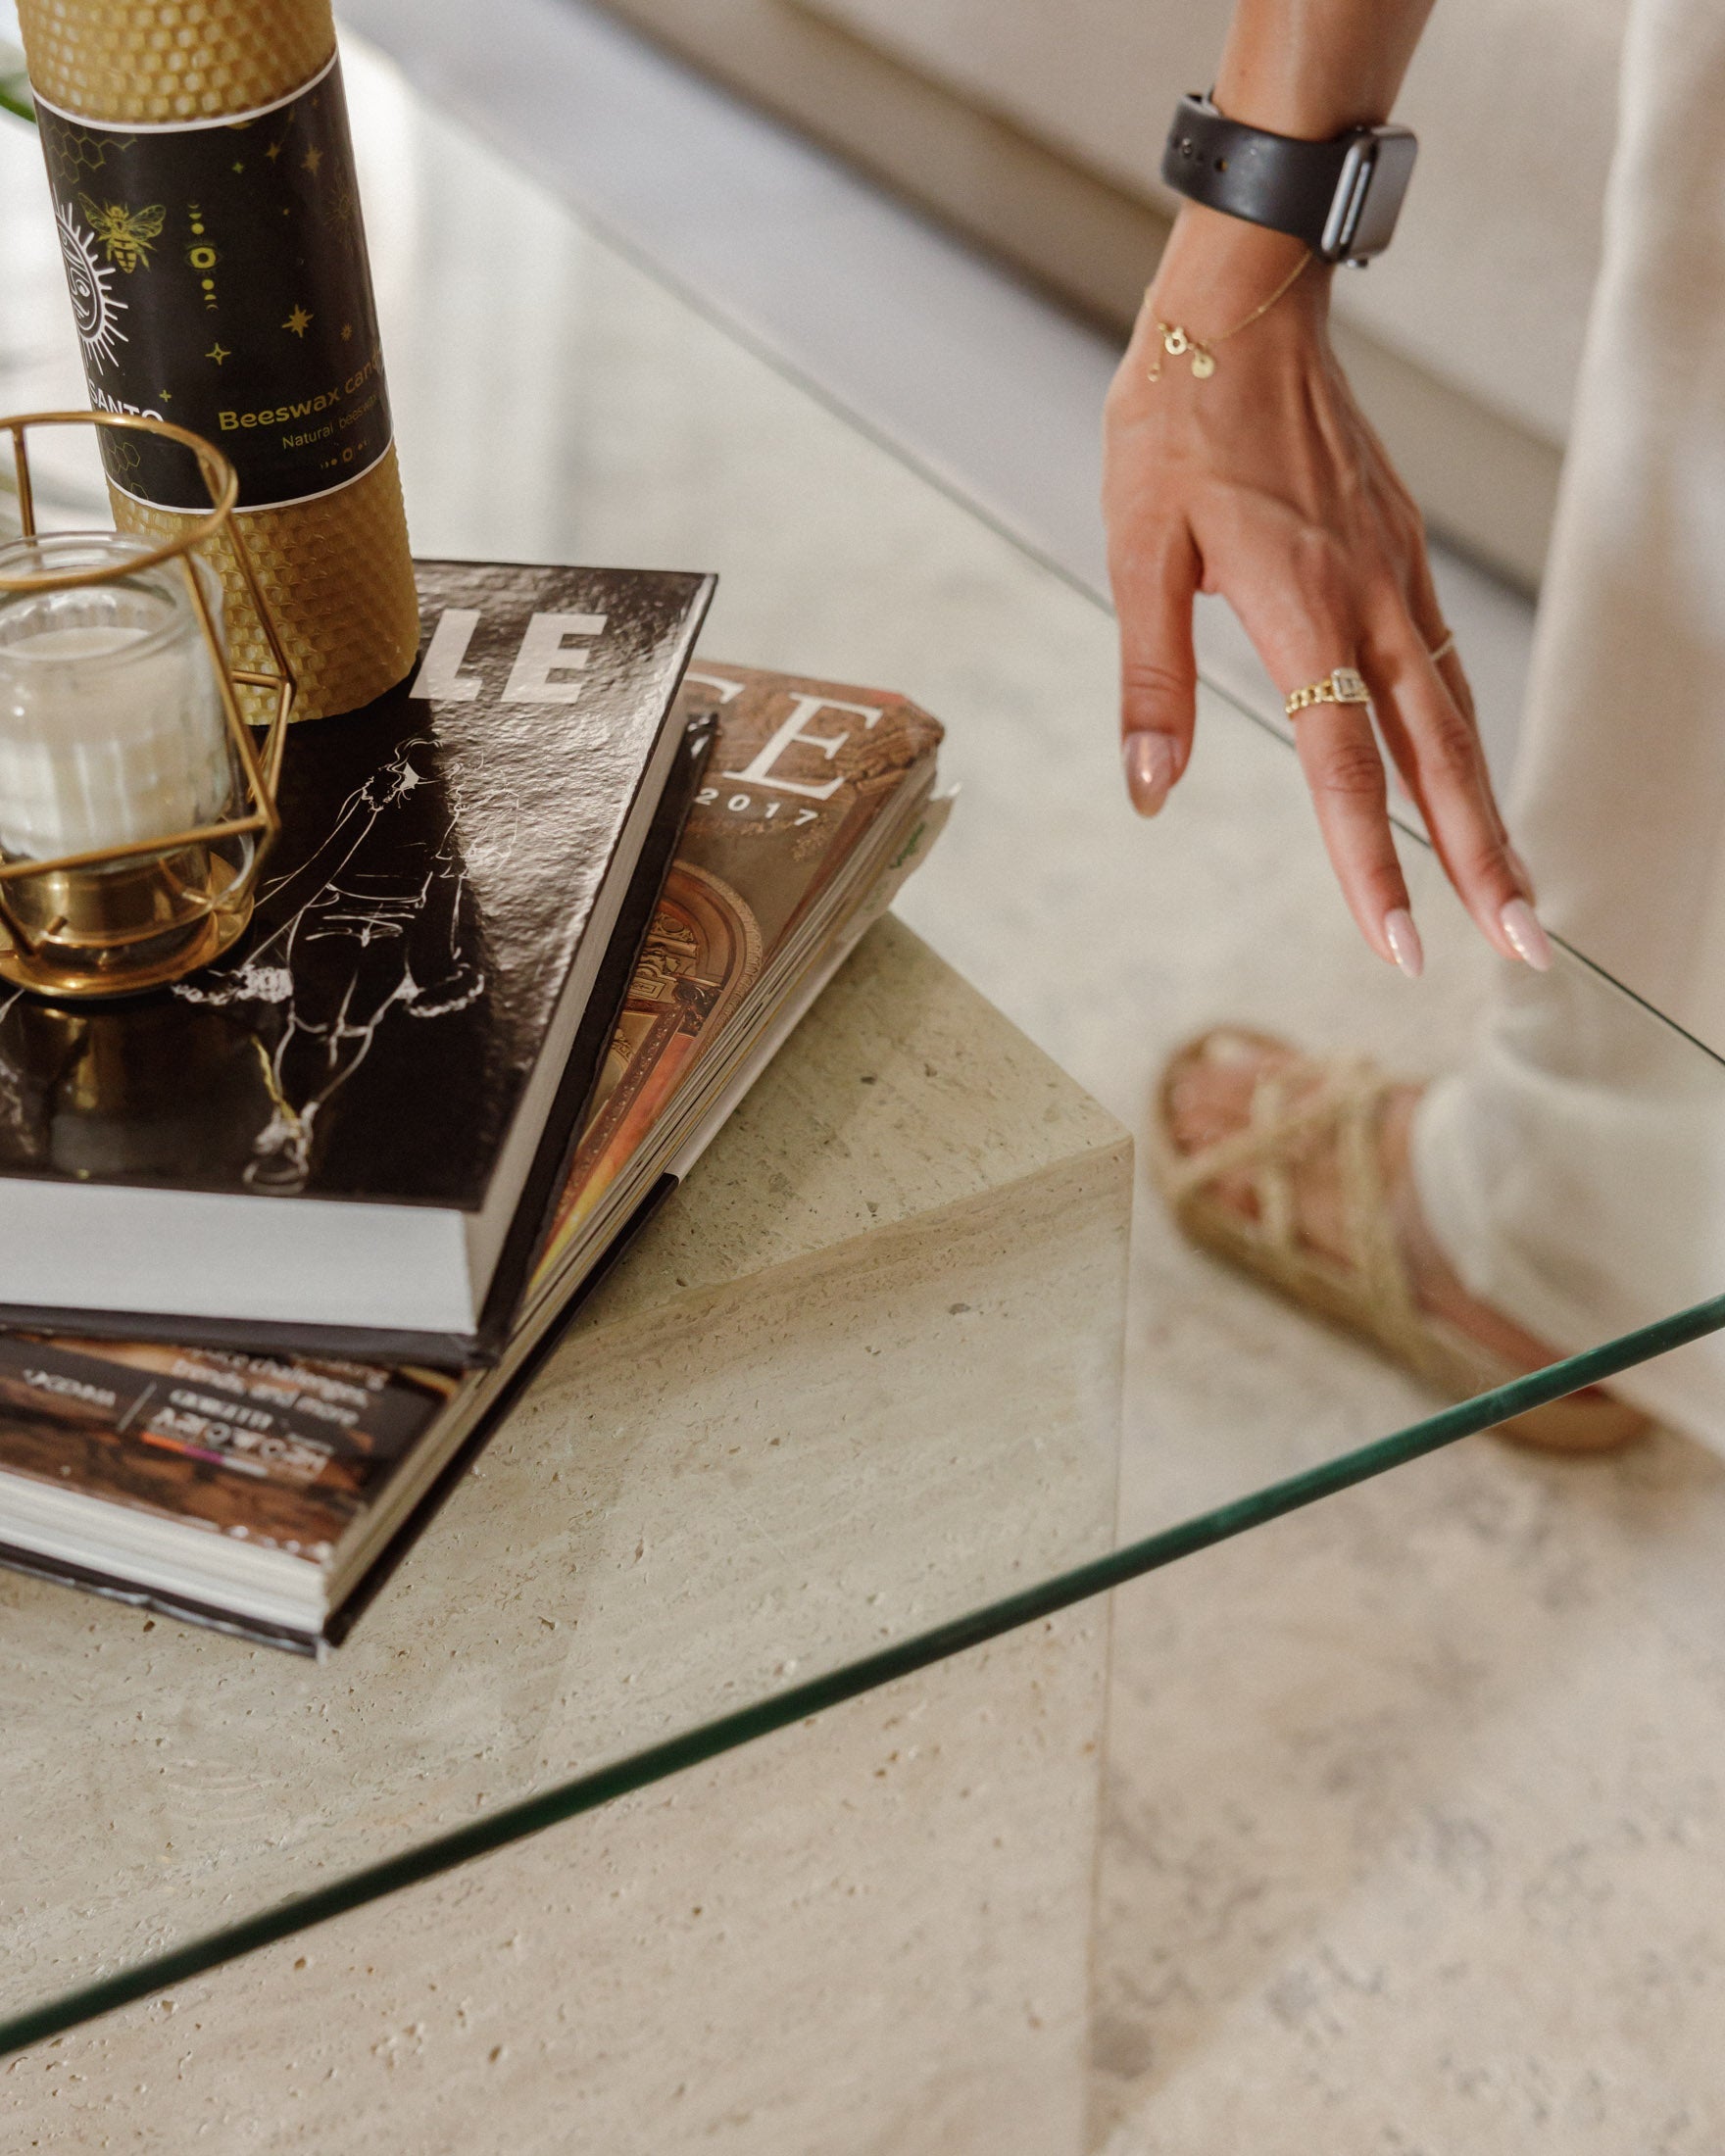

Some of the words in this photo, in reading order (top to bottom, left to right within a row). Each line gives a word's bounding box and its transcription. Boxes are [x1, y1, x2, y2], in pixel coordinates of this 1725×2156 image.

[219, 388, 341, 430] Beeswax
[281, 423, 334, 450] Natural
[694, 787, 819, 826] 2017
